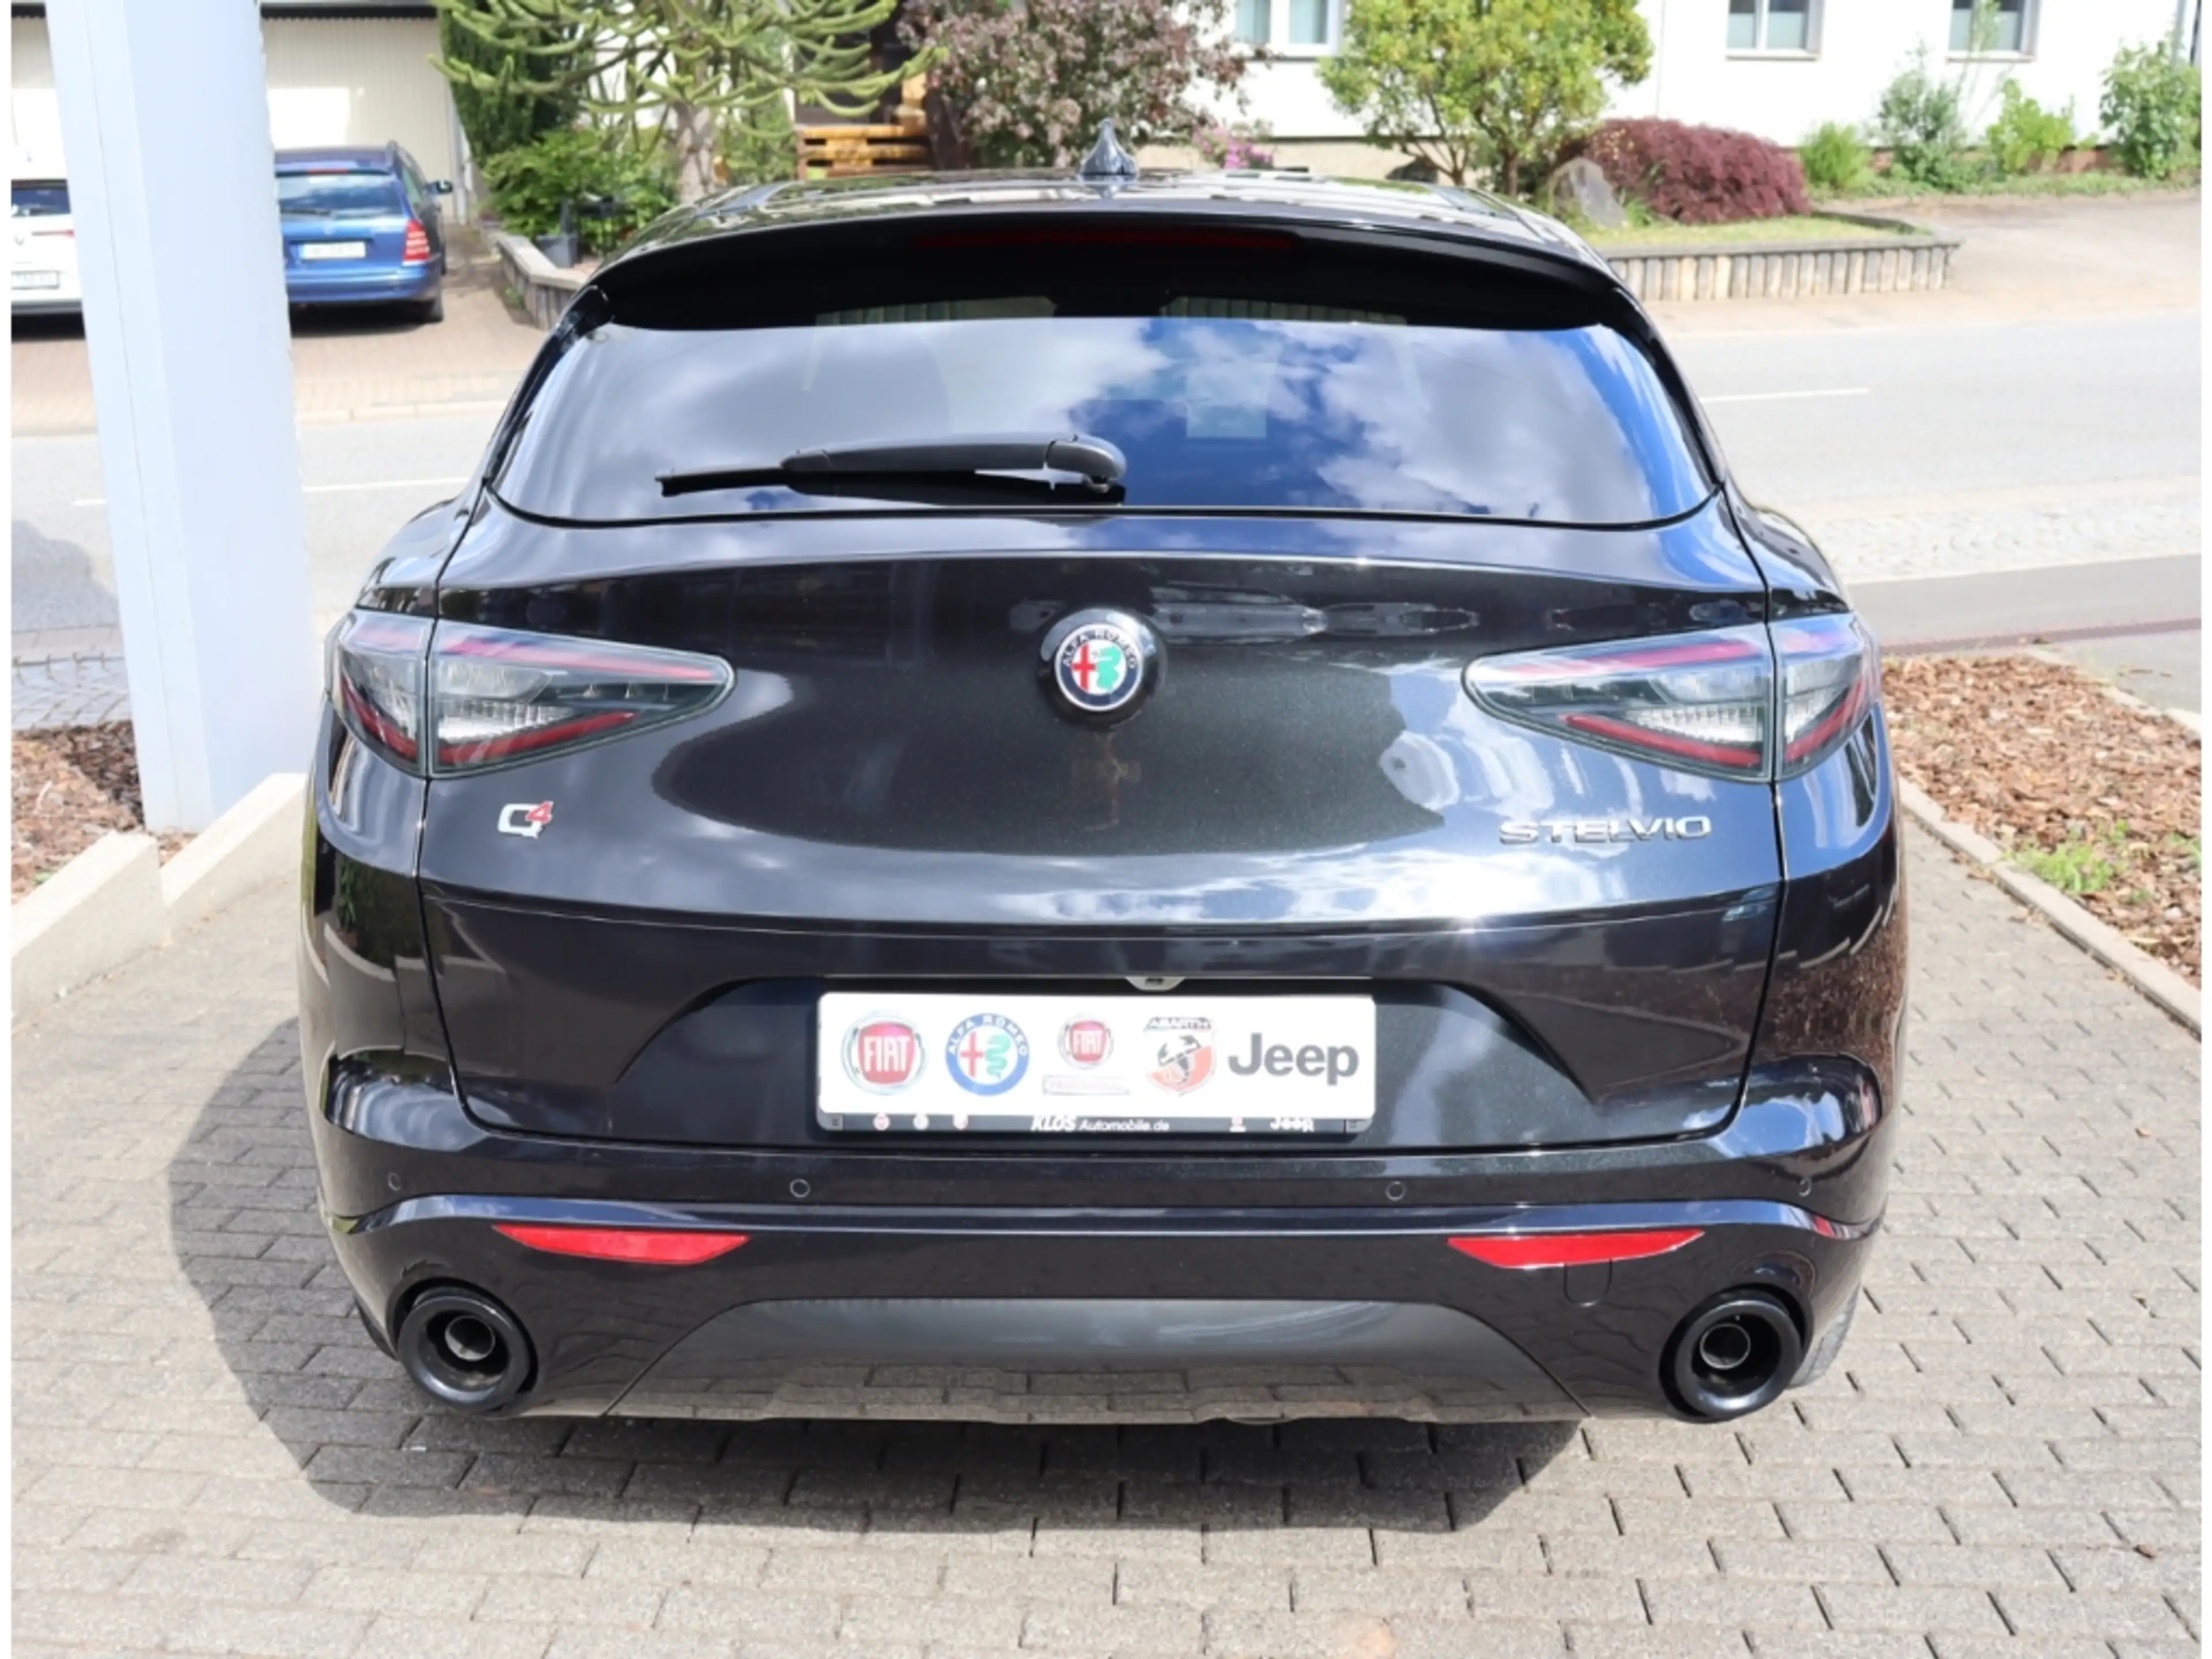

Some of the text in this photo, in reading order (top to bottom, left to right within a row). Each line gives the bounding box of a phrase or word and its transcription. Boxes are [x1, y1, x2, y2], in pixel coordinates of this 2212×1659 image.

[497, 800, 553, 839] Q4
[1499, 816, 1712, 844] STELVIO
[863, 1036, 910, 1072] FIAT
[947, 1015, 1028, 1056] ALFA ROMEO
[1073, 1030, 1104, 1055] FIAT
[1228, 1032, 1359, 1086] Jeep
